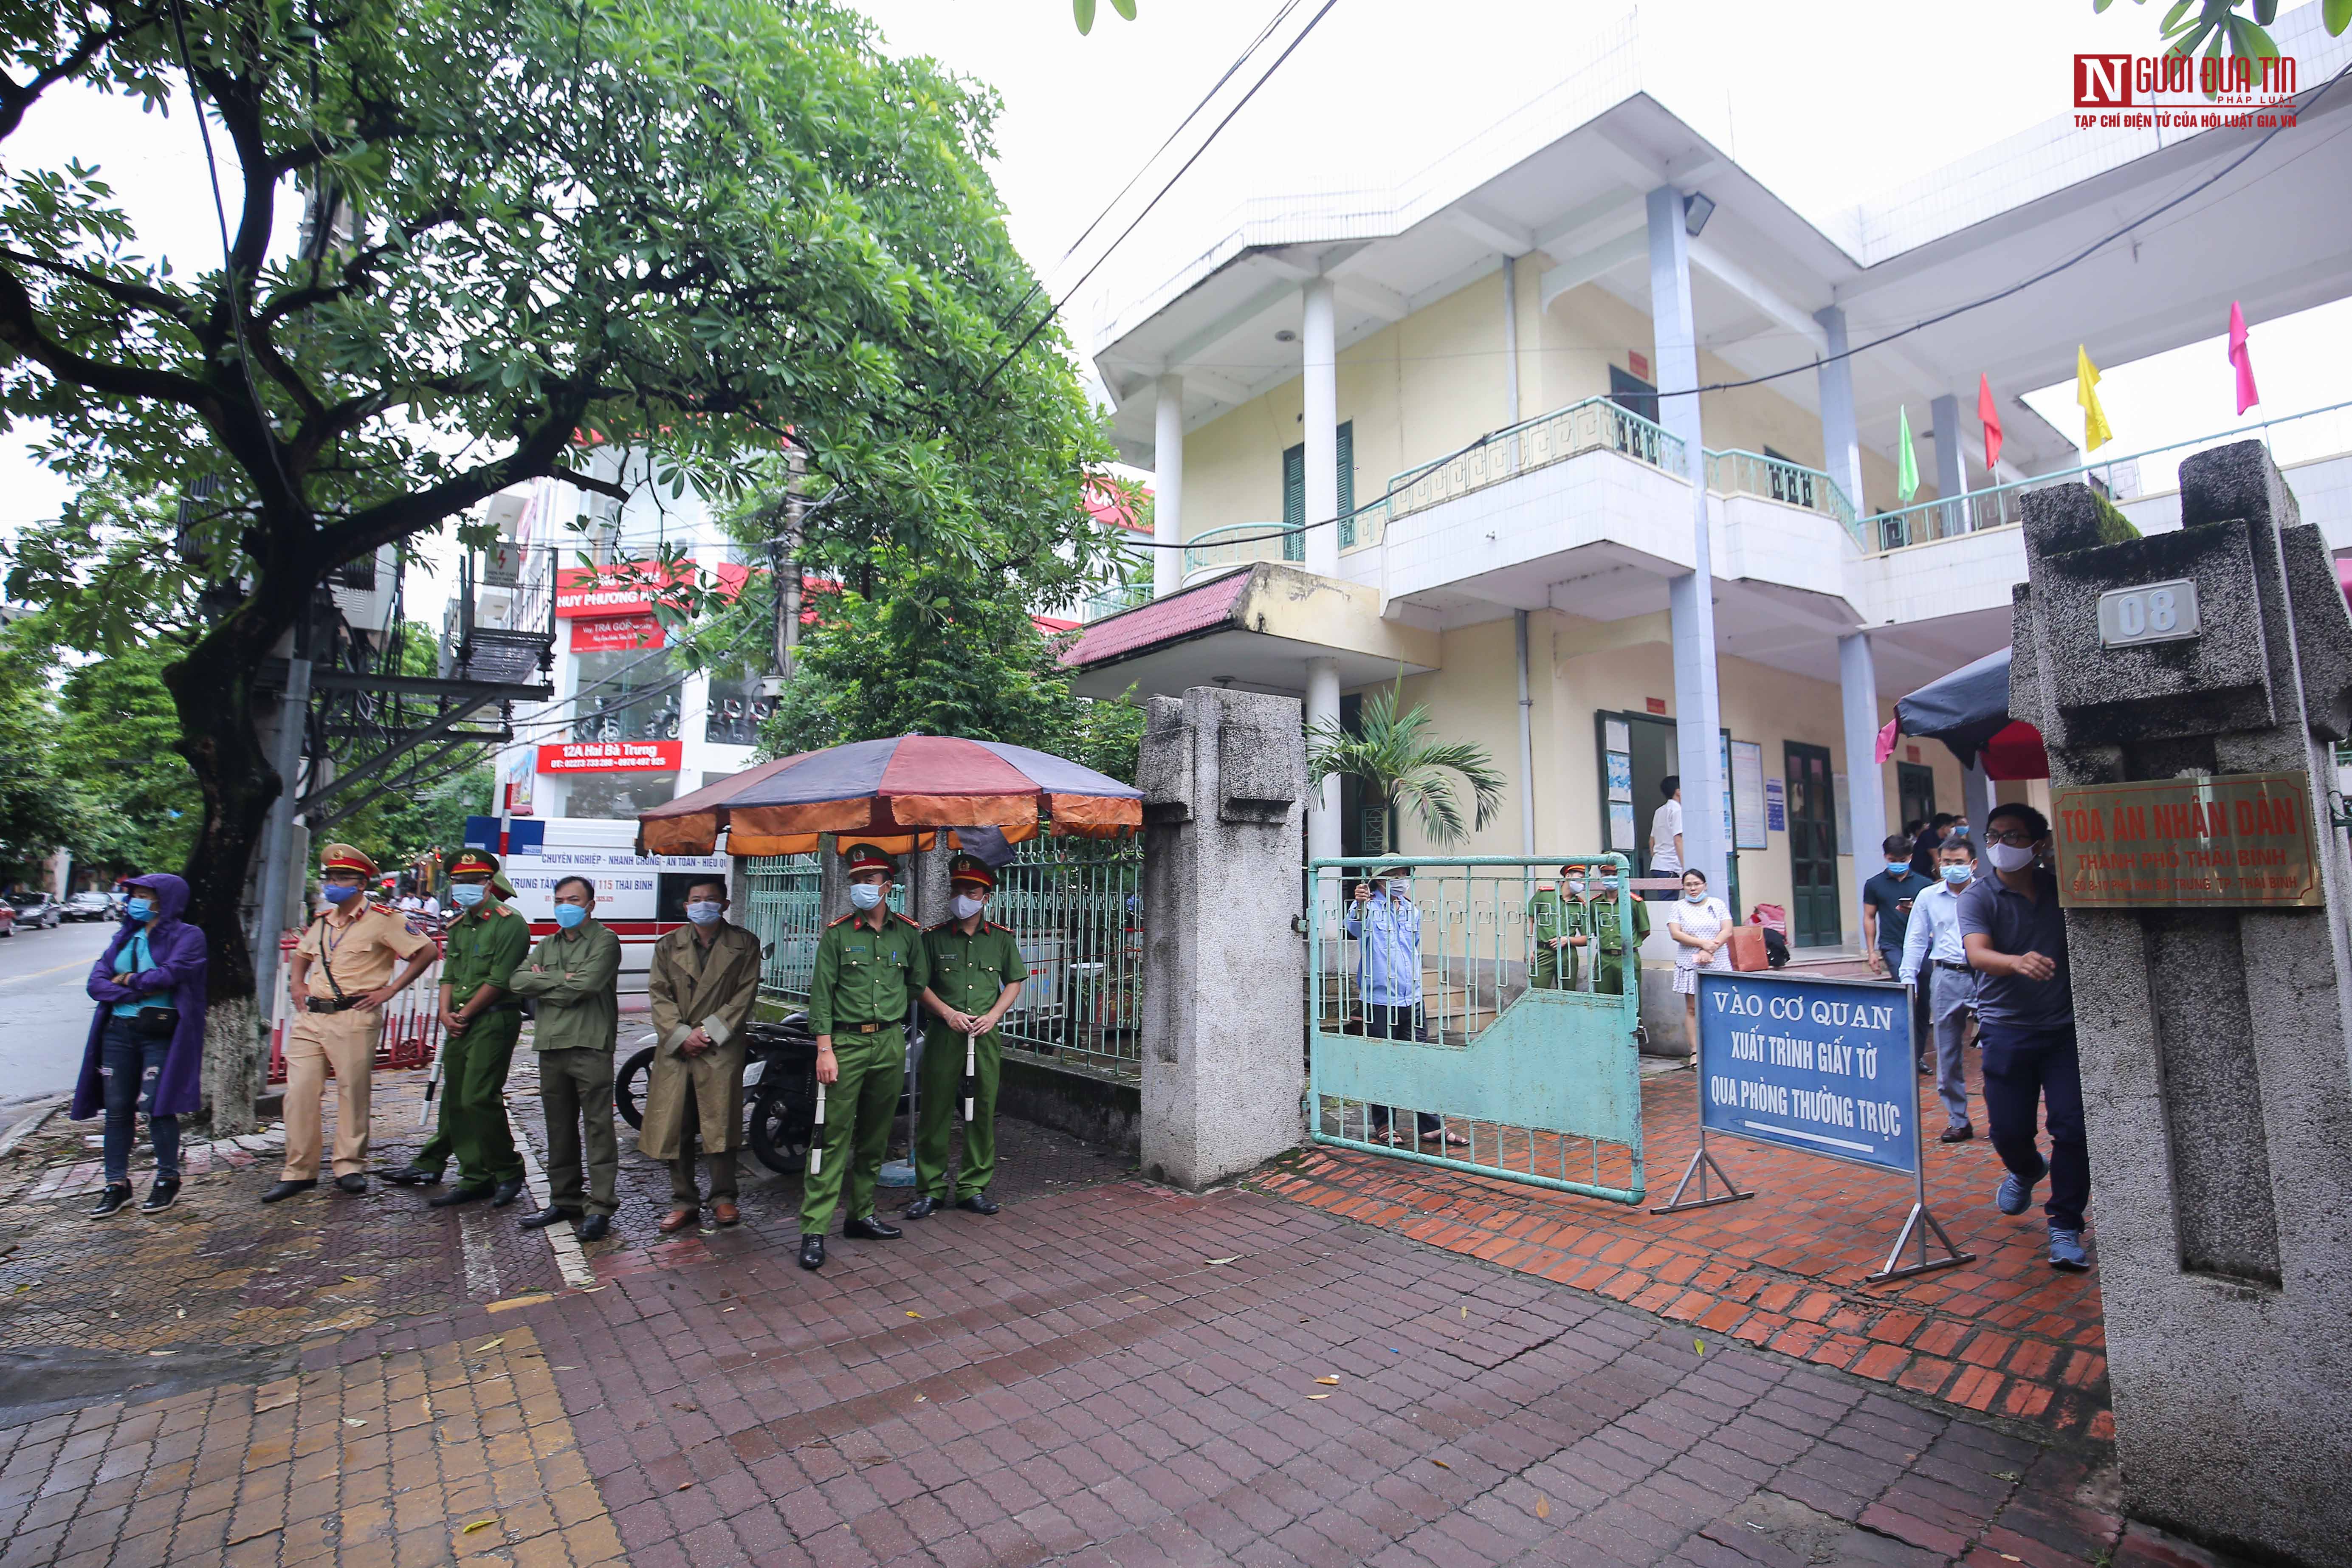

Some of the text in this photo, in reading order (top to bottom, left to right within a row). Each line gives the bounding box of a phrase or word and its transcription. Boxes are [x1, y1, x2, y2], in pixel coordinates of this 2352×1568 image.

[556, 595, 582, 608] HUY
[2118, 591, 2176, 637] 08
[563, 743, 657, 758] 12A Hai Bà Trưng
[2062, 790, 2296, 843] TÒA ÁN NHÂN DÂN
[574, 853, 601, 866] NGHIỆP
[609, 855, 633, 866] NHANH
[2076, 843, 2286, 870] THÀNH PHỐ THÁI BÌNH
[510, 877, 537, 889] TRUNG
[599, 880, 612, 890] 115
[615, 878, 632, 890] THÁI
[634, 878, 653, 890] BÌNH
[2135, 879, 2153, 891] HAI
[1713, 985, 1894, 1031] VÀO CƠ QUAN
[1730, 1024, 1878, 1080] XUẤT TRÌNH GIẤY TỜ
[1711, 1075, 1901, 1142] QUA PHÒNG THƯỜNG TRỰC
